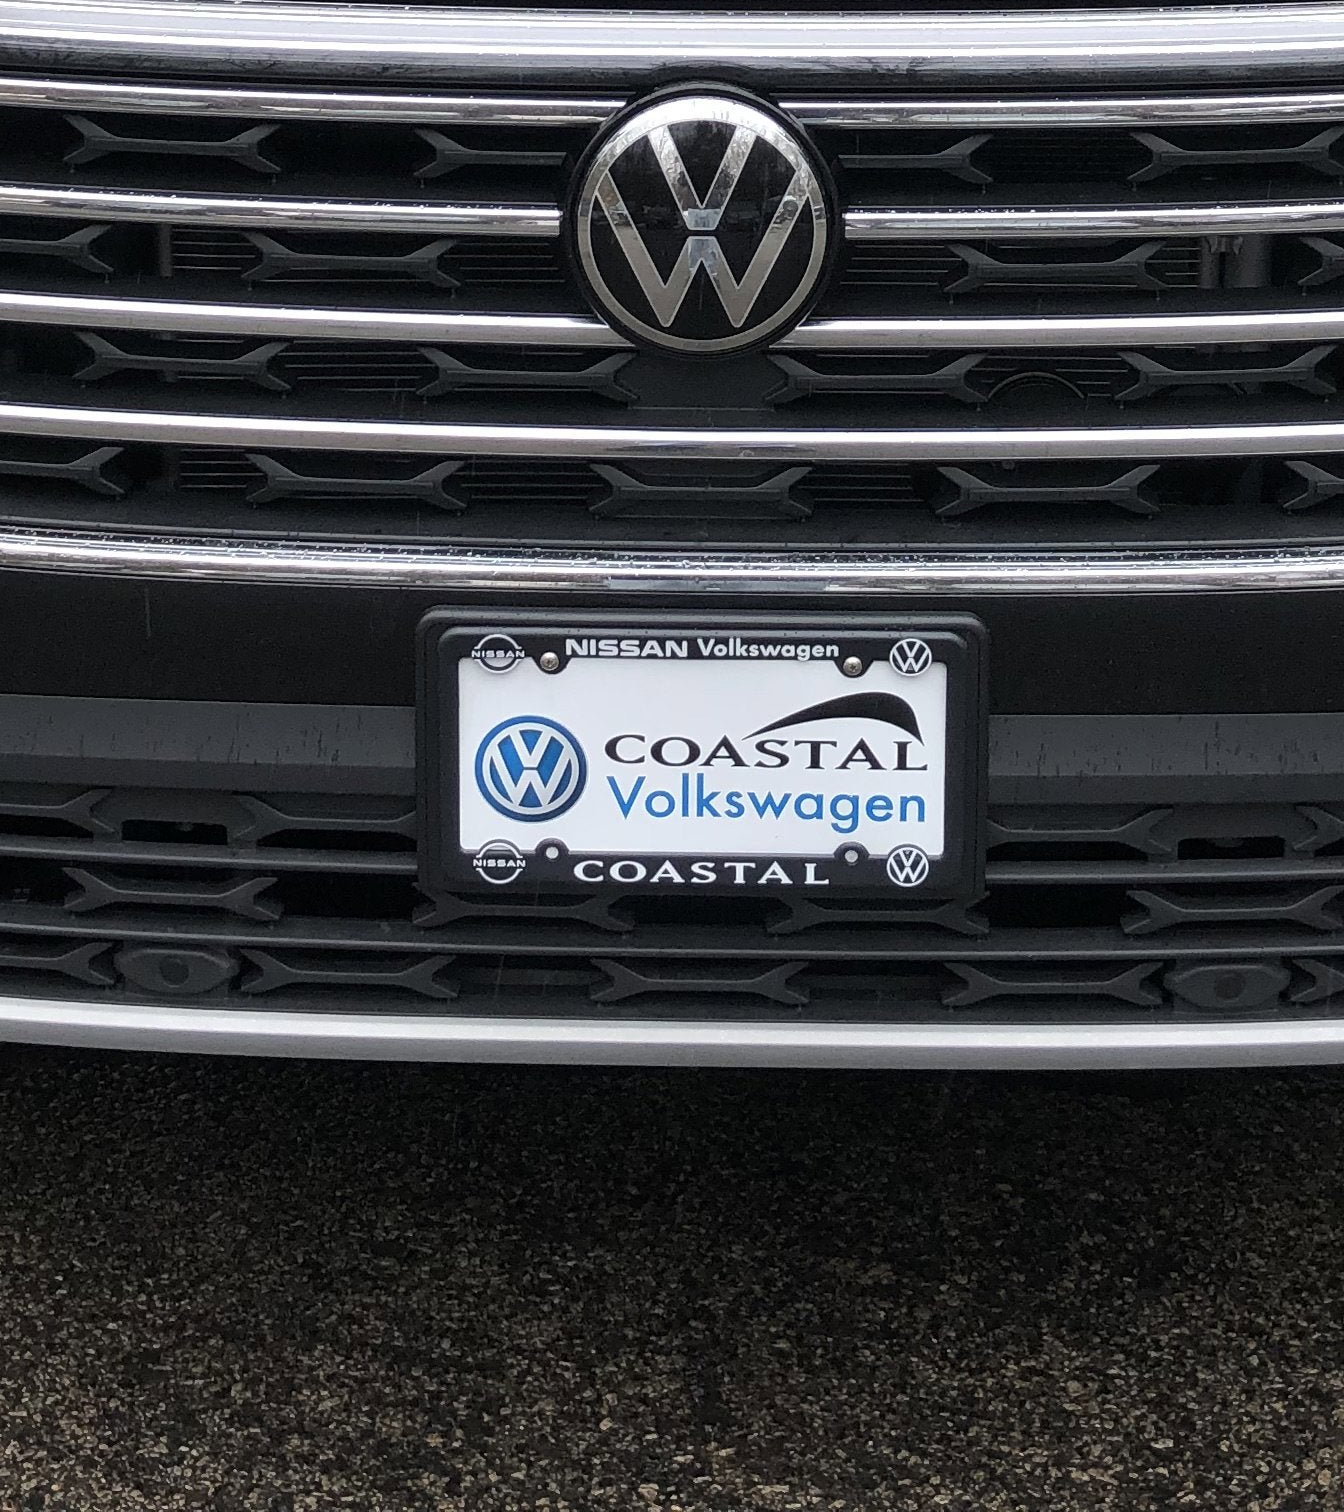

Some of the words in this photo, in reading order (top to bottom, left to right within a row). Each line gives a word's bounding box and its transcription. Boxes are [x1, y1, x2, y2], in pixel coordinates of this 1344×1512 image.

[588, 118, 816, 334] VW
[471, 649, 526, 659] NISSAN
[564, 638, 689, 658] NISSAN
[696, 637, 840, 662] Volkswagen
[889, 639, 932, 675] VW
[485, 725, 577, 811] VW
[604, 733, 928, 771] COASTAL
[605, 772, 926, 834] Volkswagen
[472, 857, 526, 868] NISSAN
[573, 859, 830, 885] COASTAL
[887, 847, 928, 886] VW
